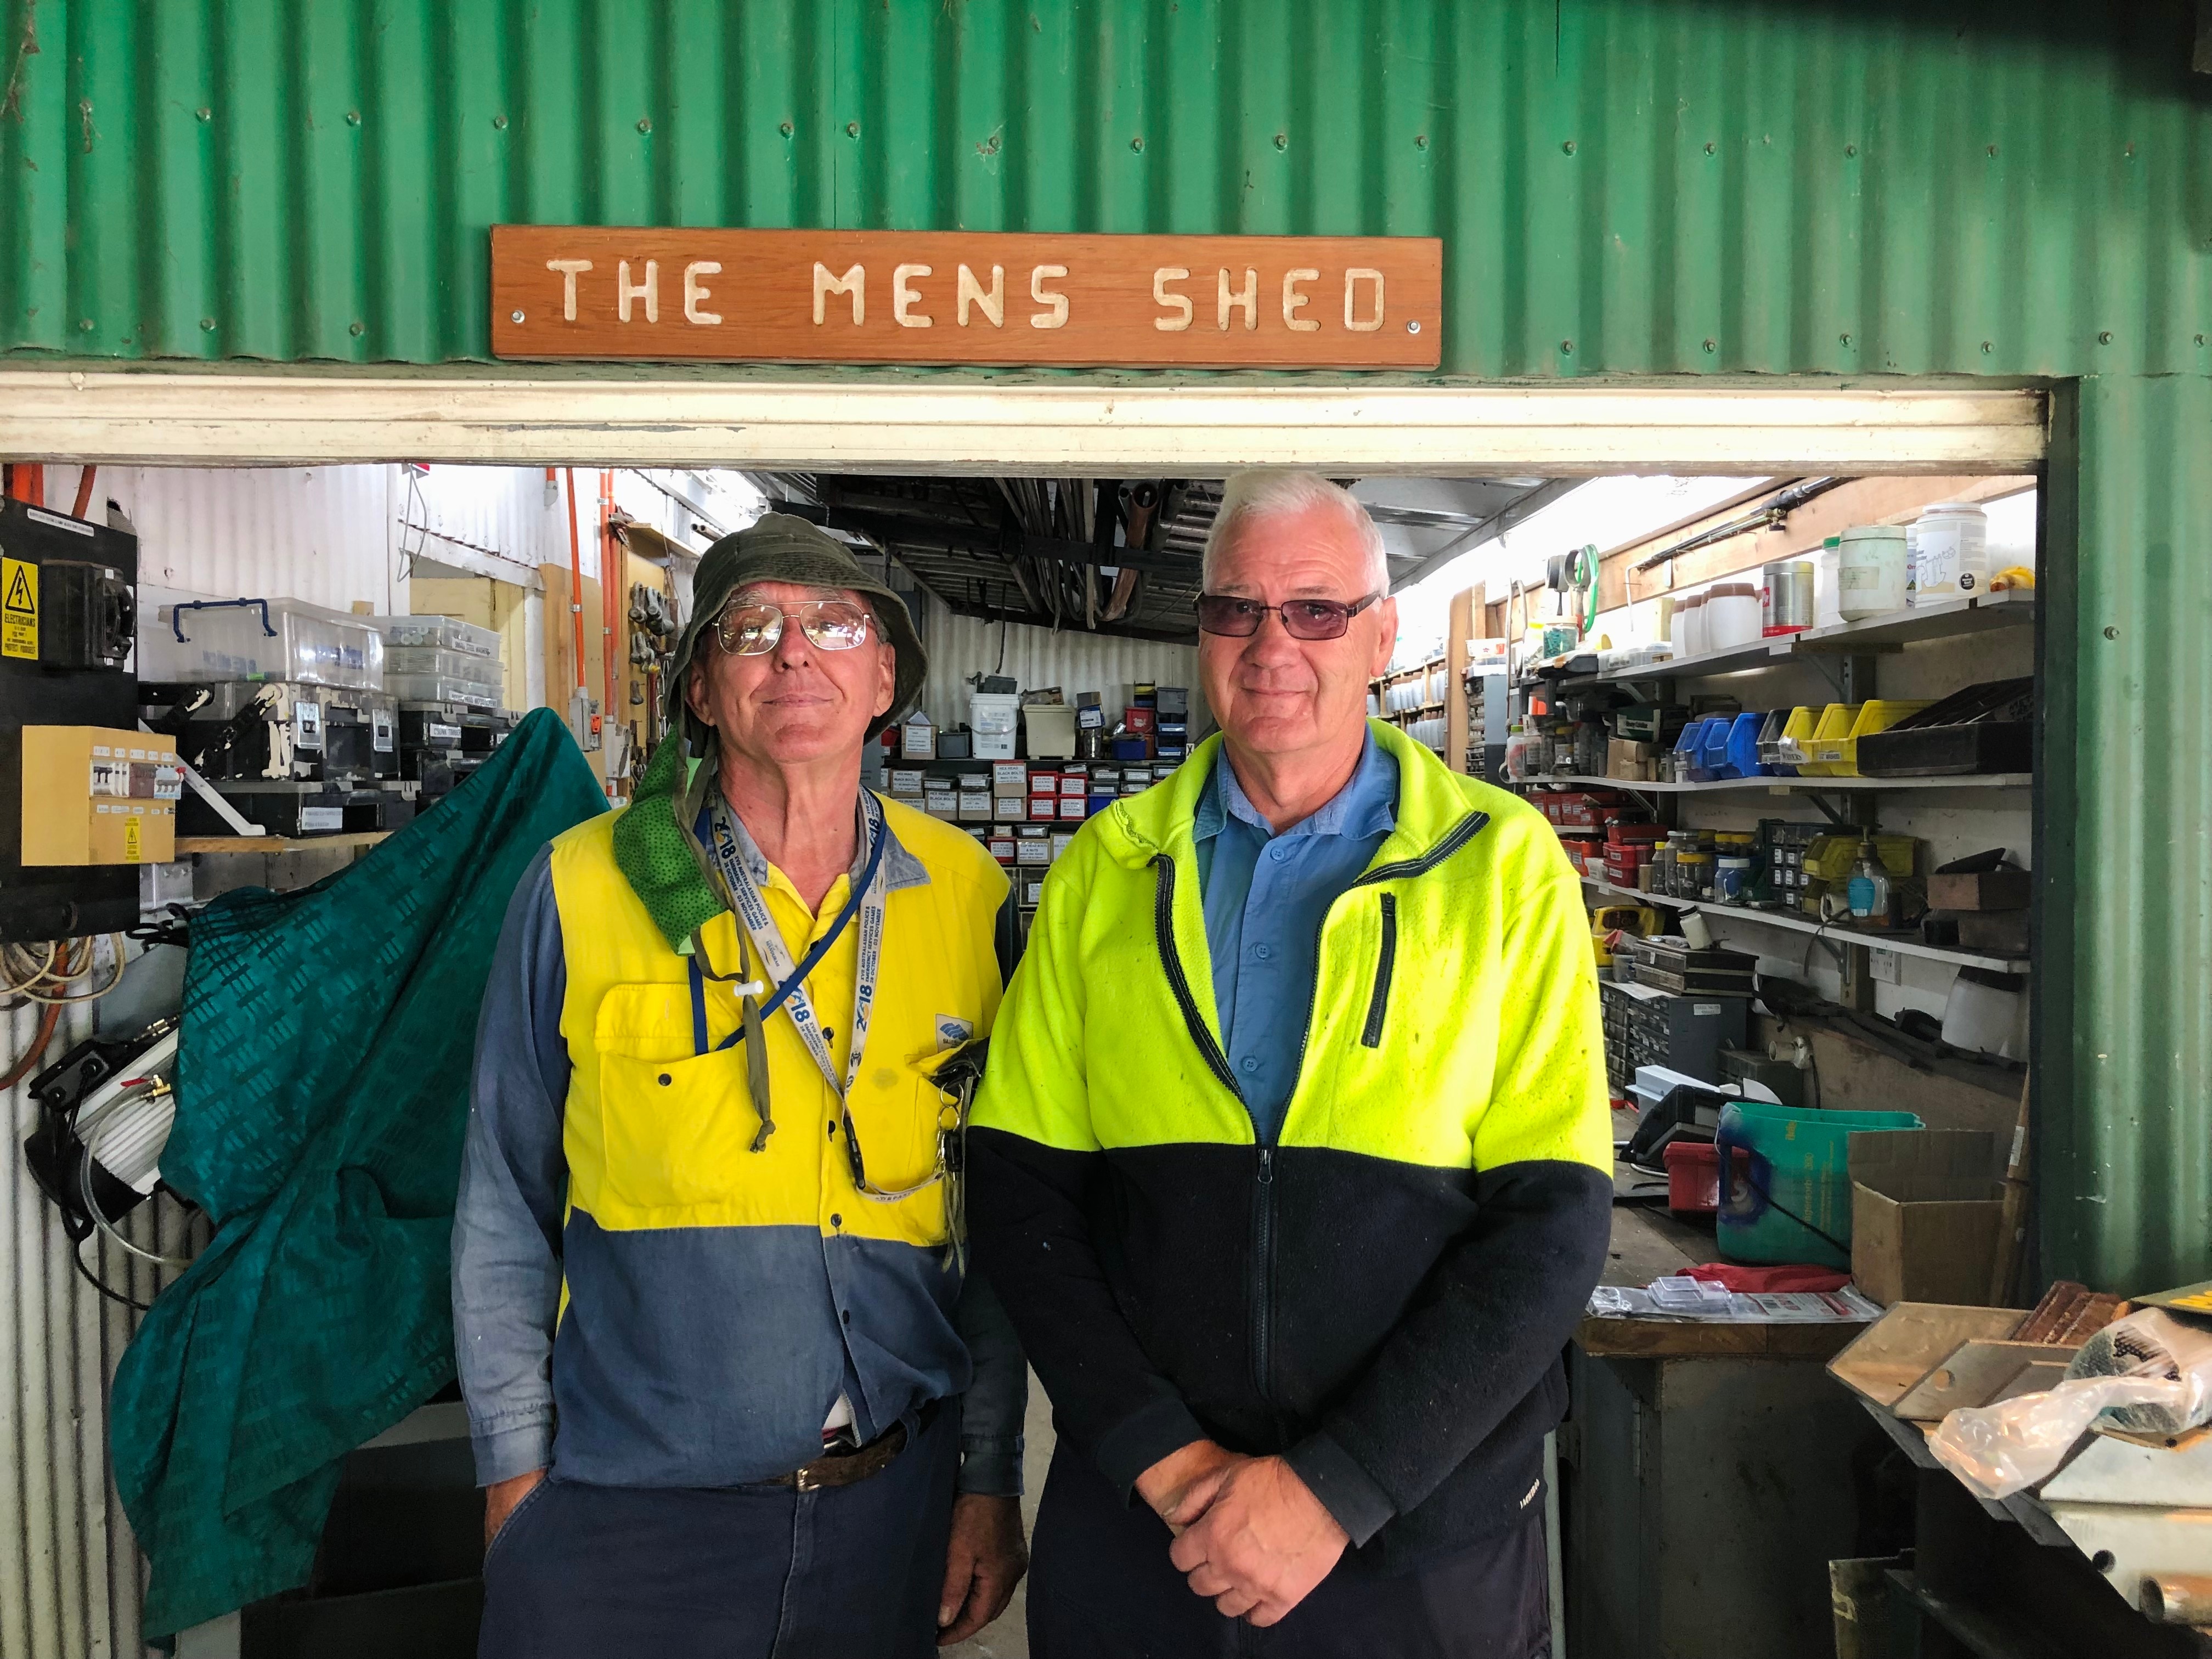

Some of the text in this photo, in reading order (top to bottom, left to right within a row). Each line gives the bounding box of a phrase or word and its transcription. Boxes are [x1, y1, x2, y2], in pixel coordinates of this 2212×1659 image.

[546, 259, 1385, 331] THE MENS SHED
[1187, 744, 1193, 756] X
[726, 868, 738, 892] OCTOBER
[740, 902, 757, 931] NOVEMBER
[729, 858, 763, 930] EMERGENCY SERVICES GAMES
[738, 866, 758, 903] AUSTRALASIAN
[755, 902, 767, 921] POLICE
